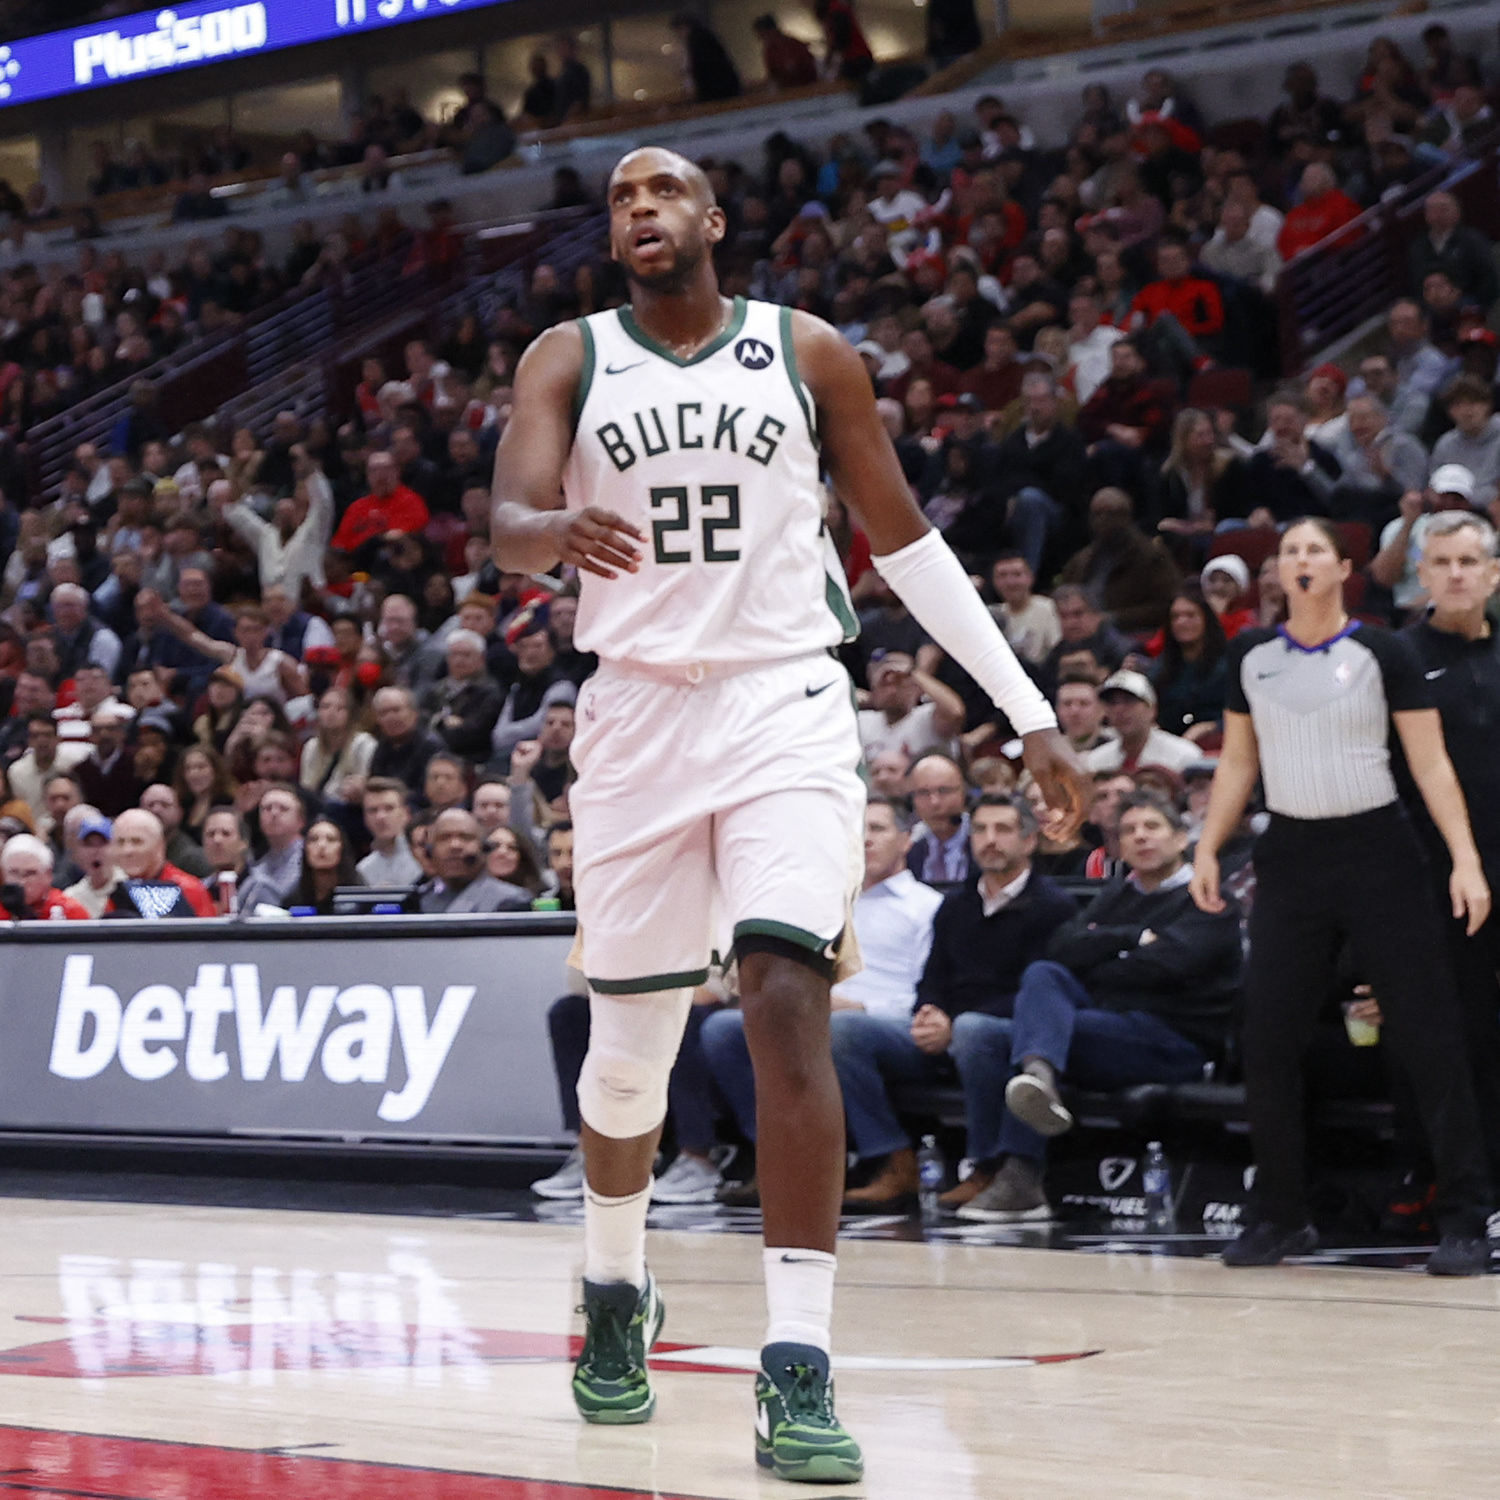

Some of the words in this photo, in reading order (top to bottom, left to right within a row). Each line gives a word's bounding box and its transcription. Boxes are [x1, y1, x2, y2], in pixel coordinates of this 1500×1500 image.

[73, 2, 267, 85] Plus500
[596, 402, 787, 473] BUCKS
[648, 483, 742, 565] 22
[49, 953, 477, 1123] betway
